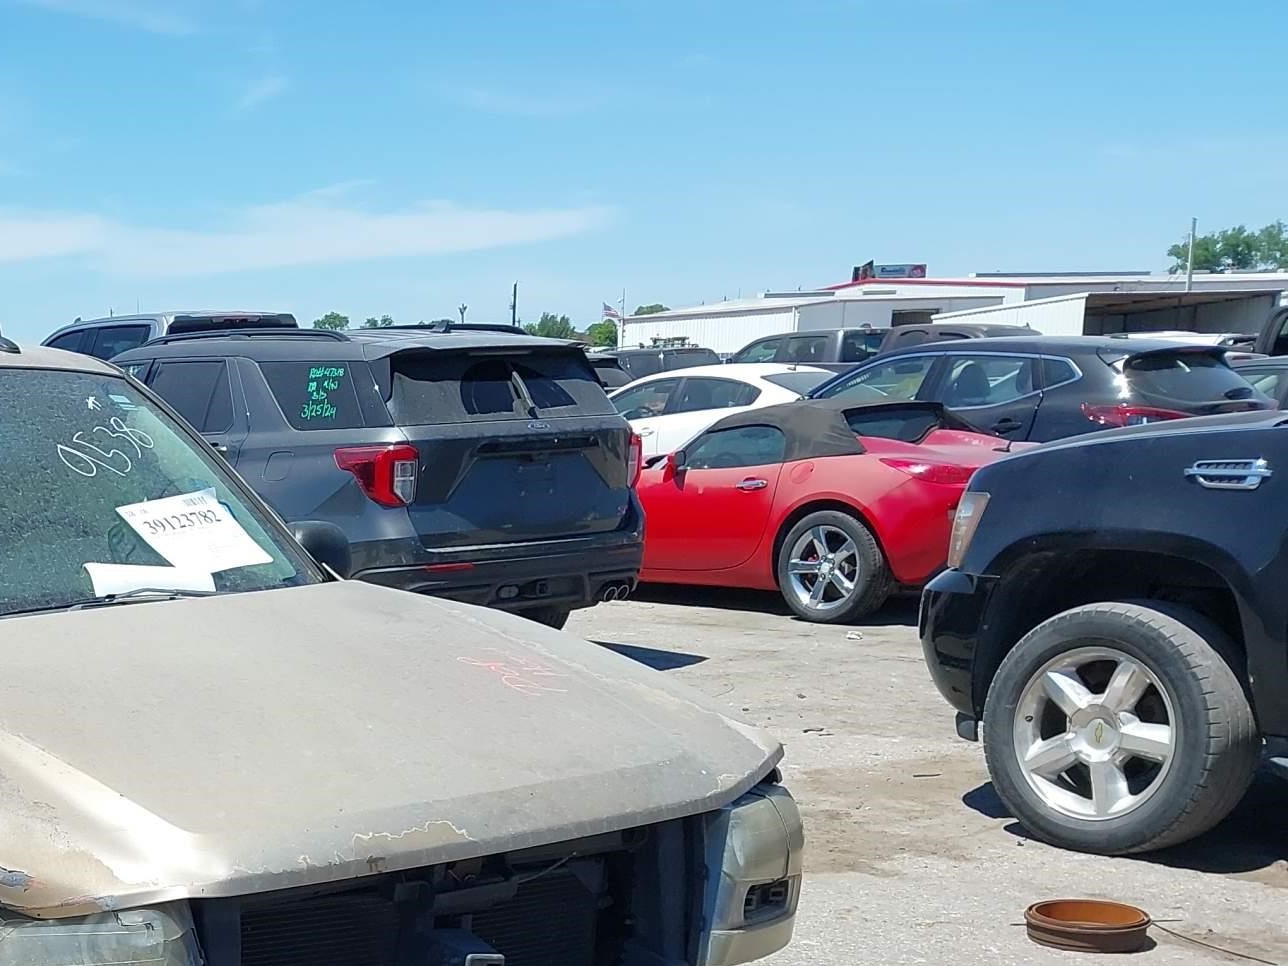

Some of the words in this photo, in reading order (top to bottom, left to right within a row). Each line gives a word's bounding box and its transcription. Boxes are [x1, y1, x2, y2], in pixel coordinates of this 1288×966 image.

[301, 399, 337, 420] 3/25/24
[57, 416, 154, 477] 9538
[143, 509, 222, 535] 39123782
